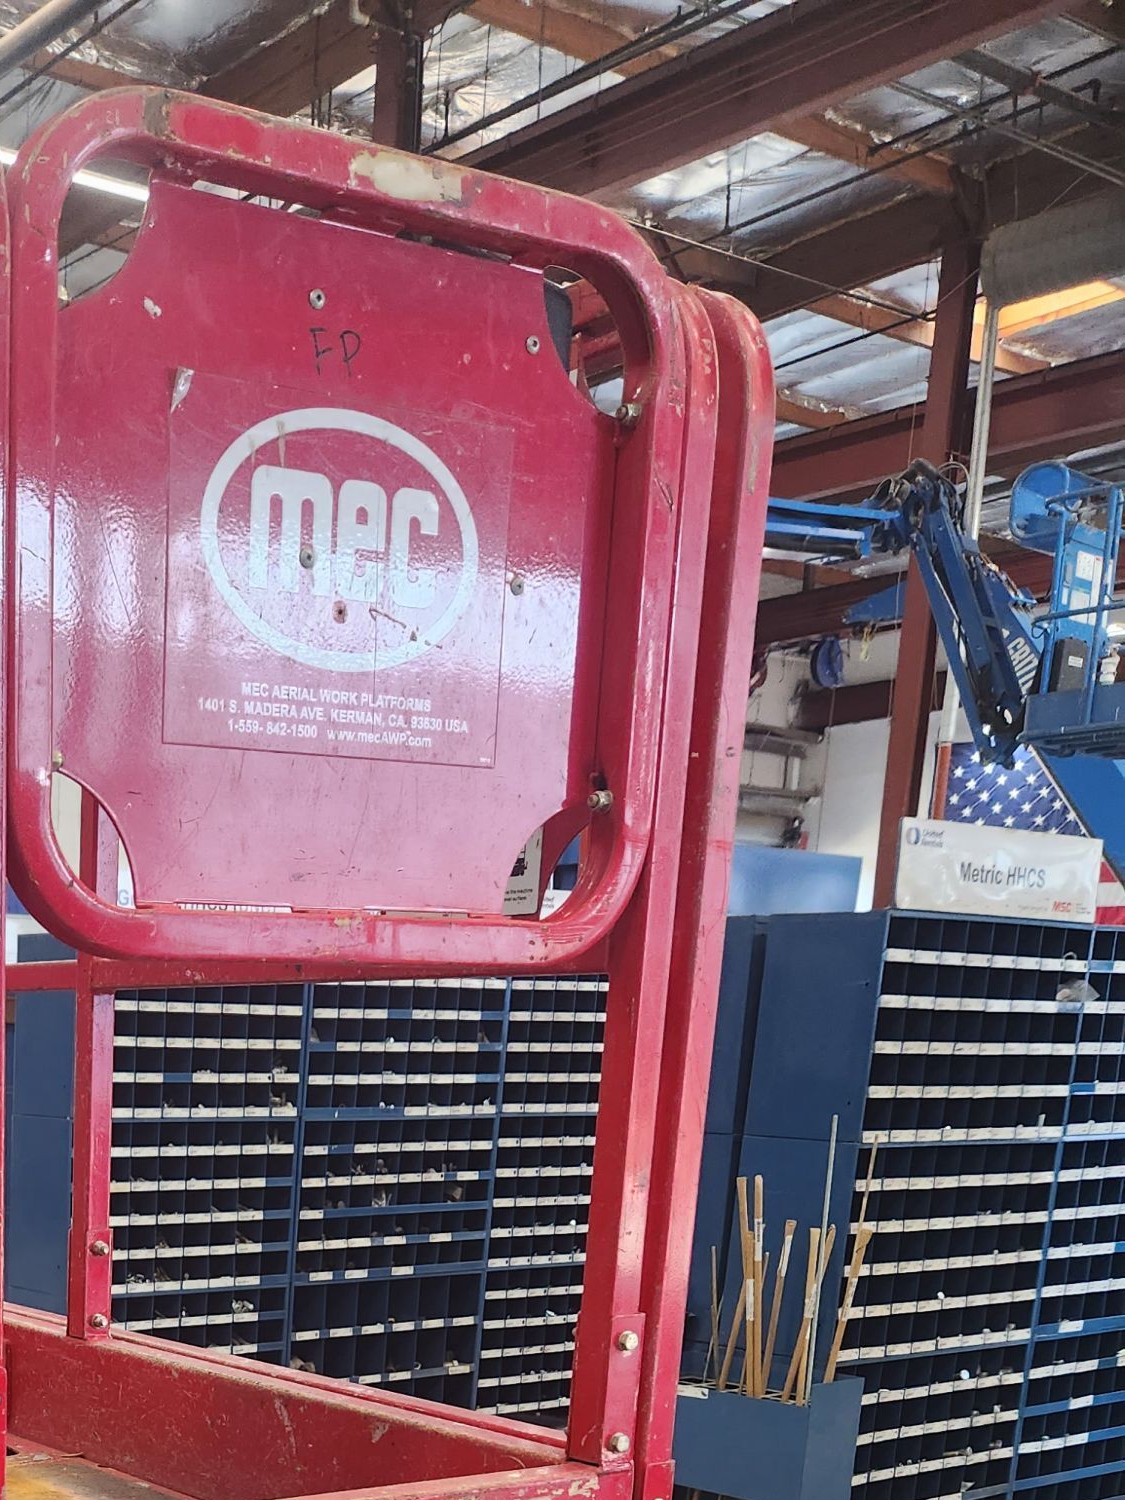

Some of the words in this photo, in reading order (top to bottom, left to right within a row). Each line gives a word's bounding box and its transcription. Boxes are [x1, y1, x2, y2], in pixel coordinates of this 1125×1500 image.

[241, 682, 269, 696] MEC
[271, 684, 317, 702] AERIAL
[319, 688, 358, 705] WORK
[361, 692, 432, 712] PLATFORMS
[198, 696, 225, 712] 1401
[229, 700, 241, 714] S.
[244, 700, 299, 719] MADERA
[330, 708, 385, 727] KERMAN,
[445, 718, 469, 733] USA
[327, 729, 432, 747] www.mecAWP.com
[960, 861, 1003, 885] Metric
[1006, 865, 1046, 889] HHCS
